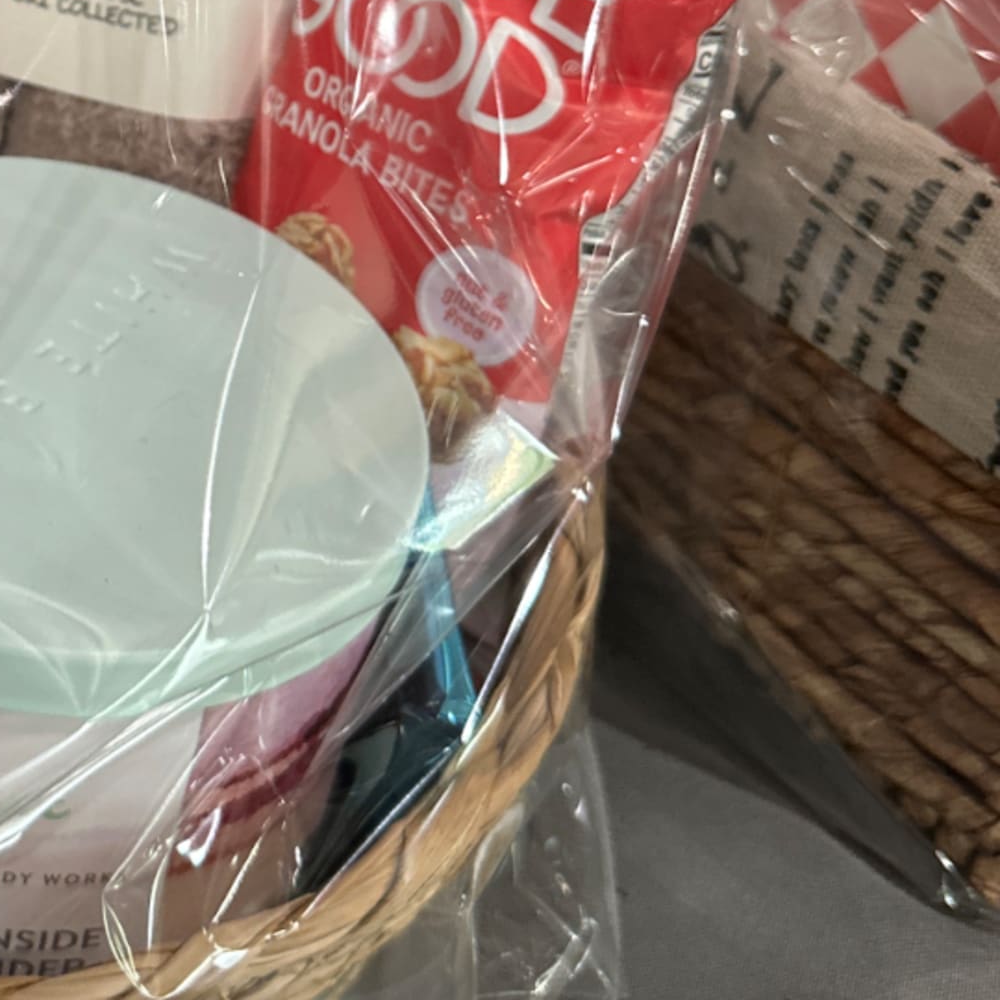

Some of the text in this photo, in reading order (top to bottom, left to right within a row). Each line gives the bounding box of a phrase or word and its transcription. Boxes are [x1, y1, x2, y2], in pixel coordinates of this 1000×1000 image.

[304, 66, 433, 154] ORGANIC
[378, 153, 474, 225] BITES
[42, 871, 123, 888] WORK
